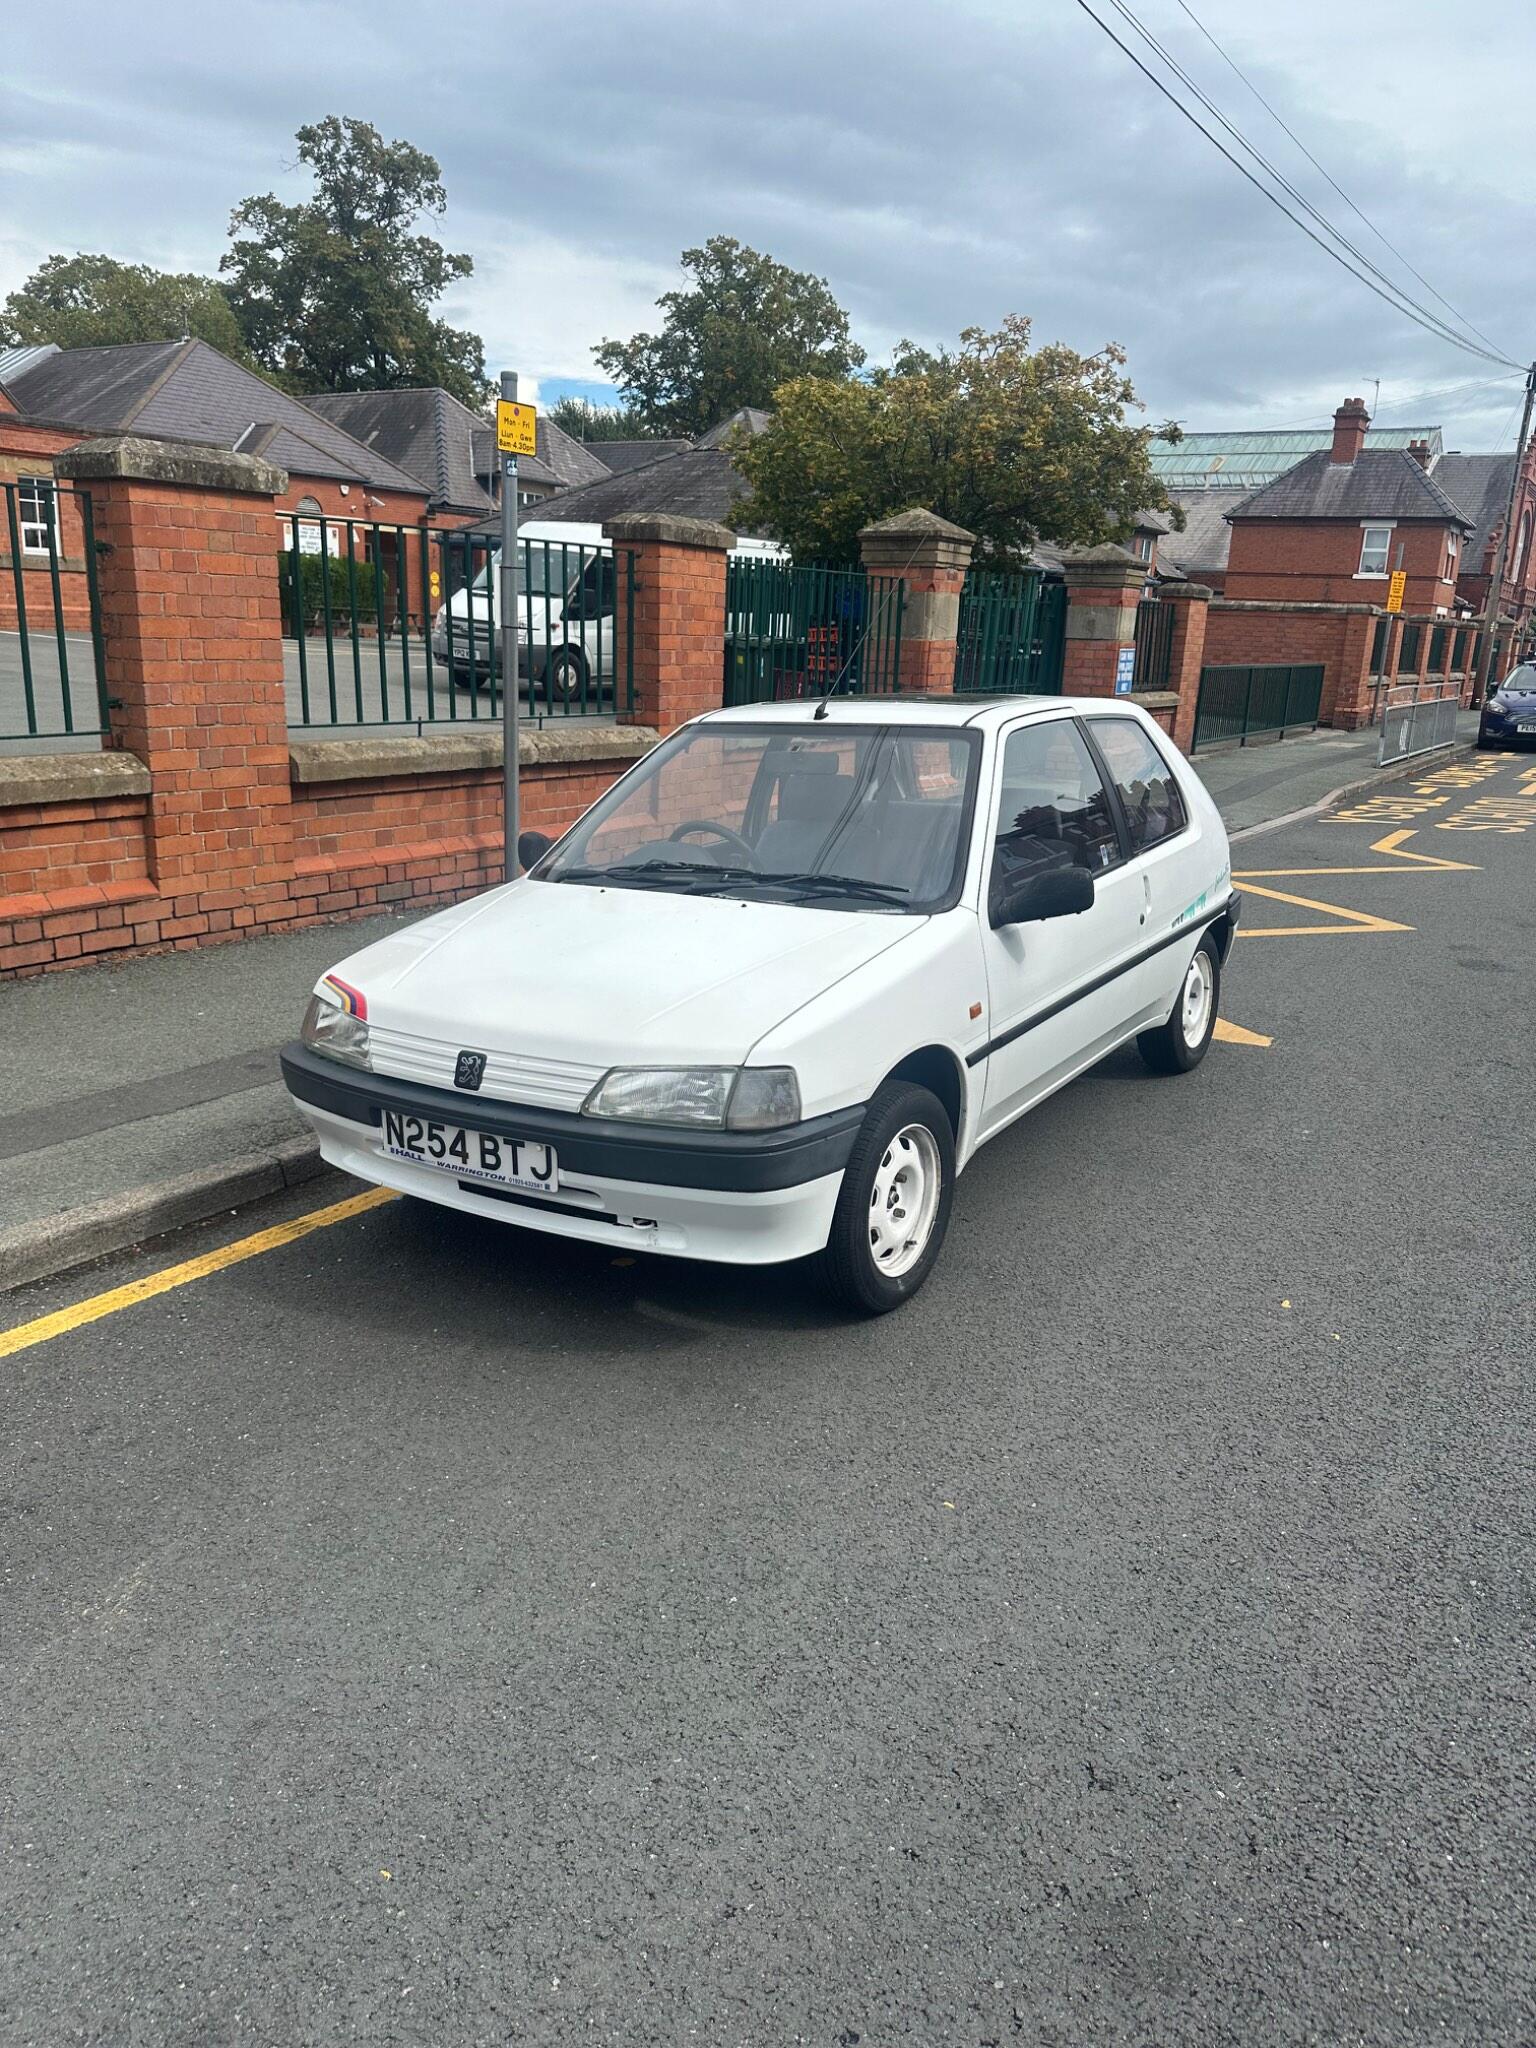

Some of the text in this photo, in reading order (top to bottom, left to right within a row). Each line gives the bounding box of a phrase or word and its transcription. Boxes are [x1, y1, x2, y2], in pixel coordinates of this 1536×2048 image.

[504, 417, 530, 429] Mon Fri
[1318, 795, 1452, 824] YSGOL
[386, 1111, 553, 1181] N254 BTJ
[436, 1160, 506, 1182] WARRINGTON
